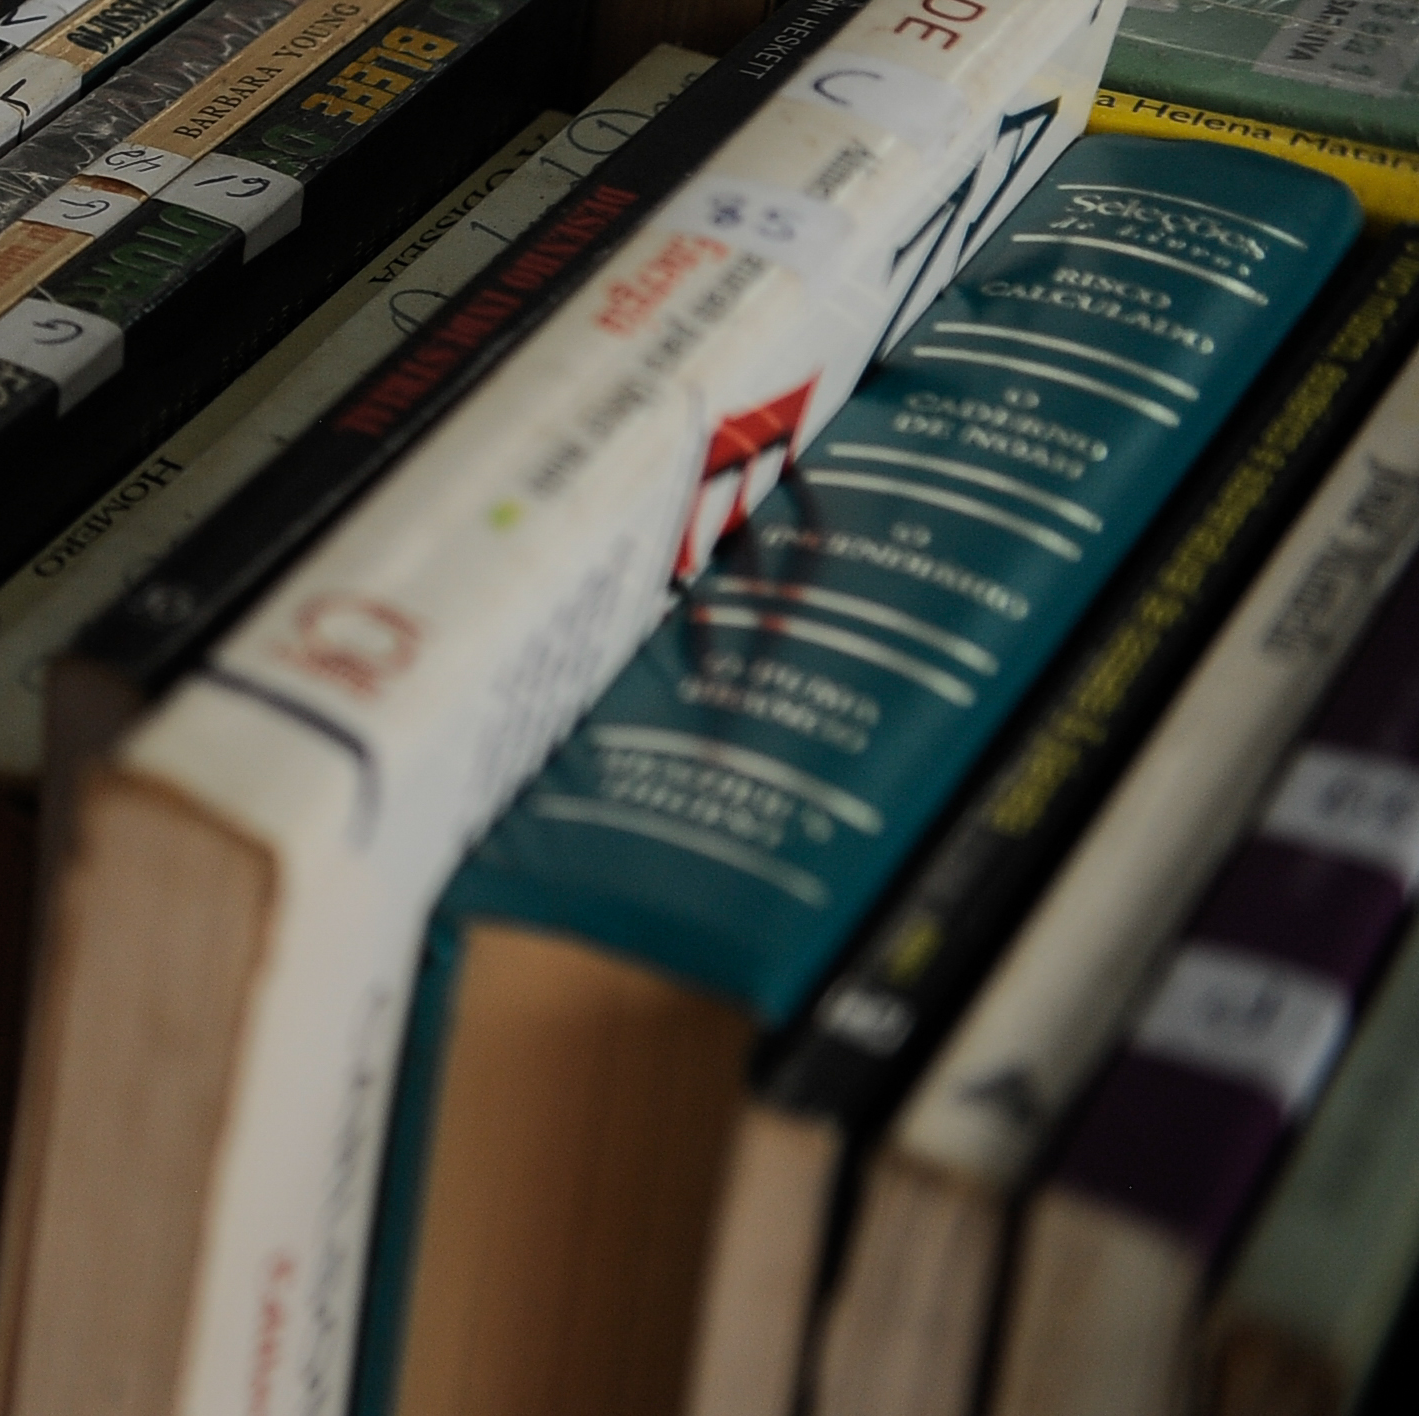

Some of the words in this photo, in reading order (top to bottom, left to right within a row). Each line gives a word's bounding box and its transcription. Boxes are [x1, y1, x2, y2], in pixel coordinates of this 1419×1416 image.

[173, 62, 284, 141] BARBARA
[272, 0, 361, 62] YOUNG
[301, 24, 459, 126] BLEFE
[739, 16, 821, 81] HESKETT
[1131, 97, 1272, 141] Helena
[34, 456, 186, 579] HOMERO
